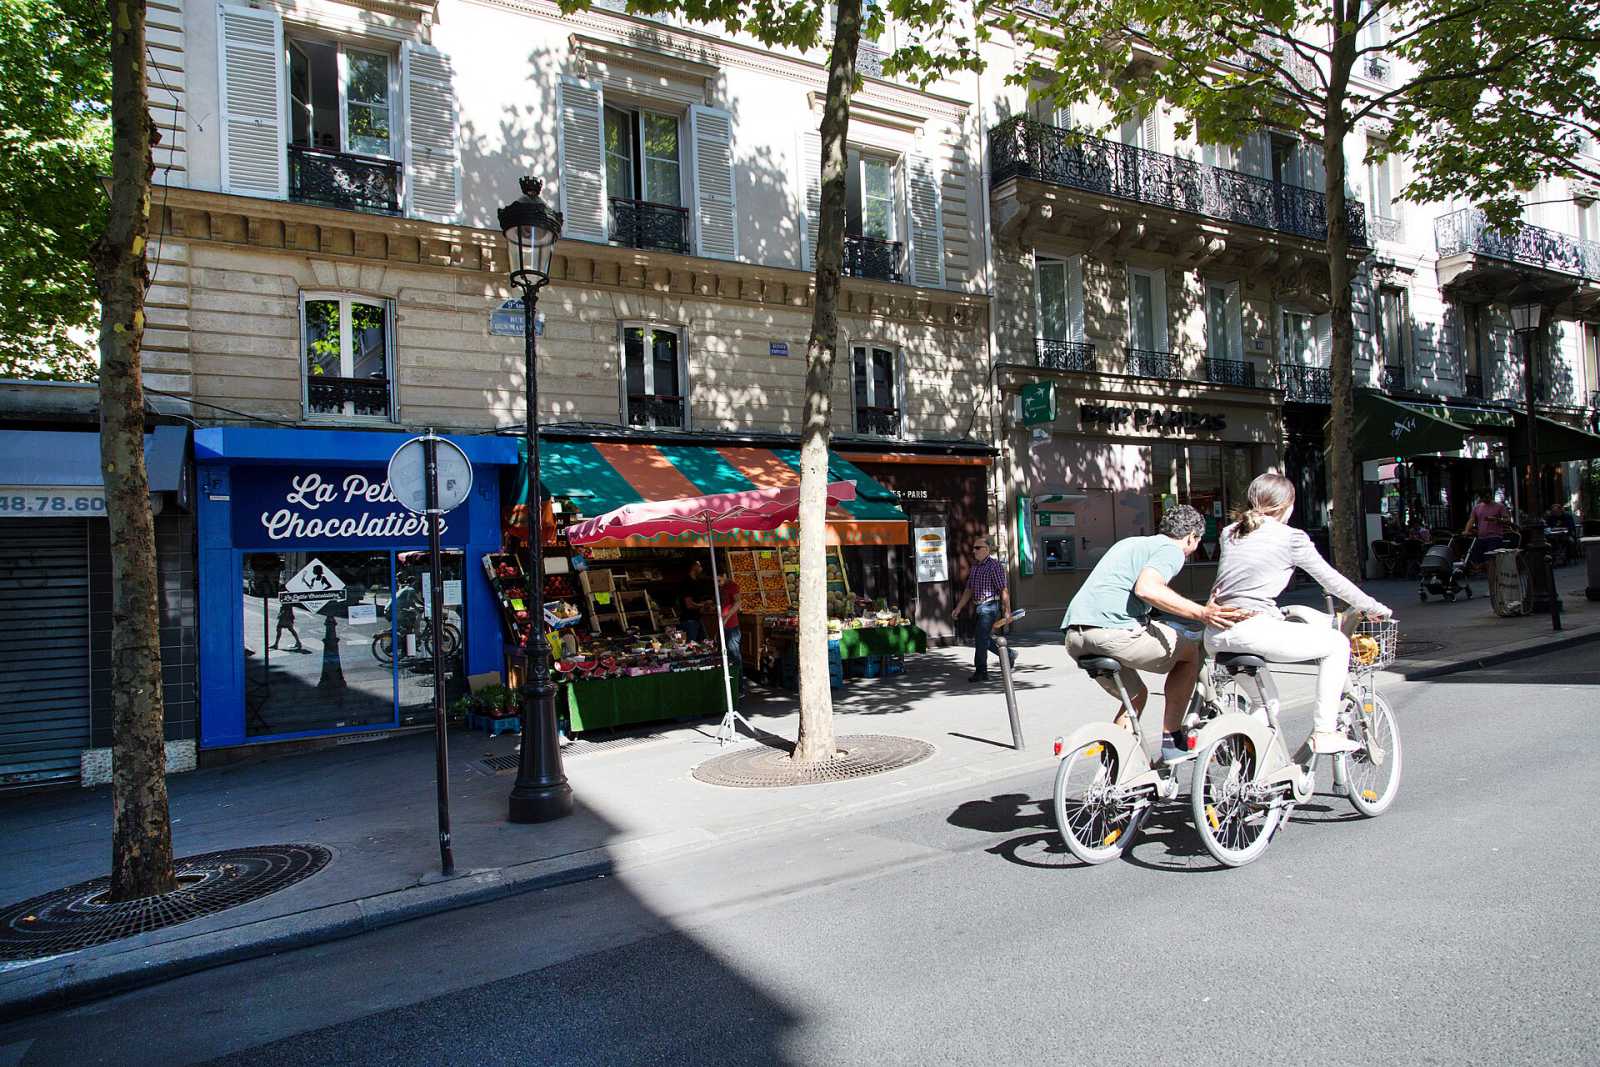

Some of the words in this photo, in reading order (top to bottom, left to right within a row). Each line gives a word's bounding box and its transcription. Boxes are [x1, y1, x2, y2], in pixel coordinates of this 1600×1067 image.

[286, 473, 337, 509] La
[342, 474, 399, 503] Pet
[907, 490, 928, 499] PARIS
[261, 509, 449, 540] Chocolatière
